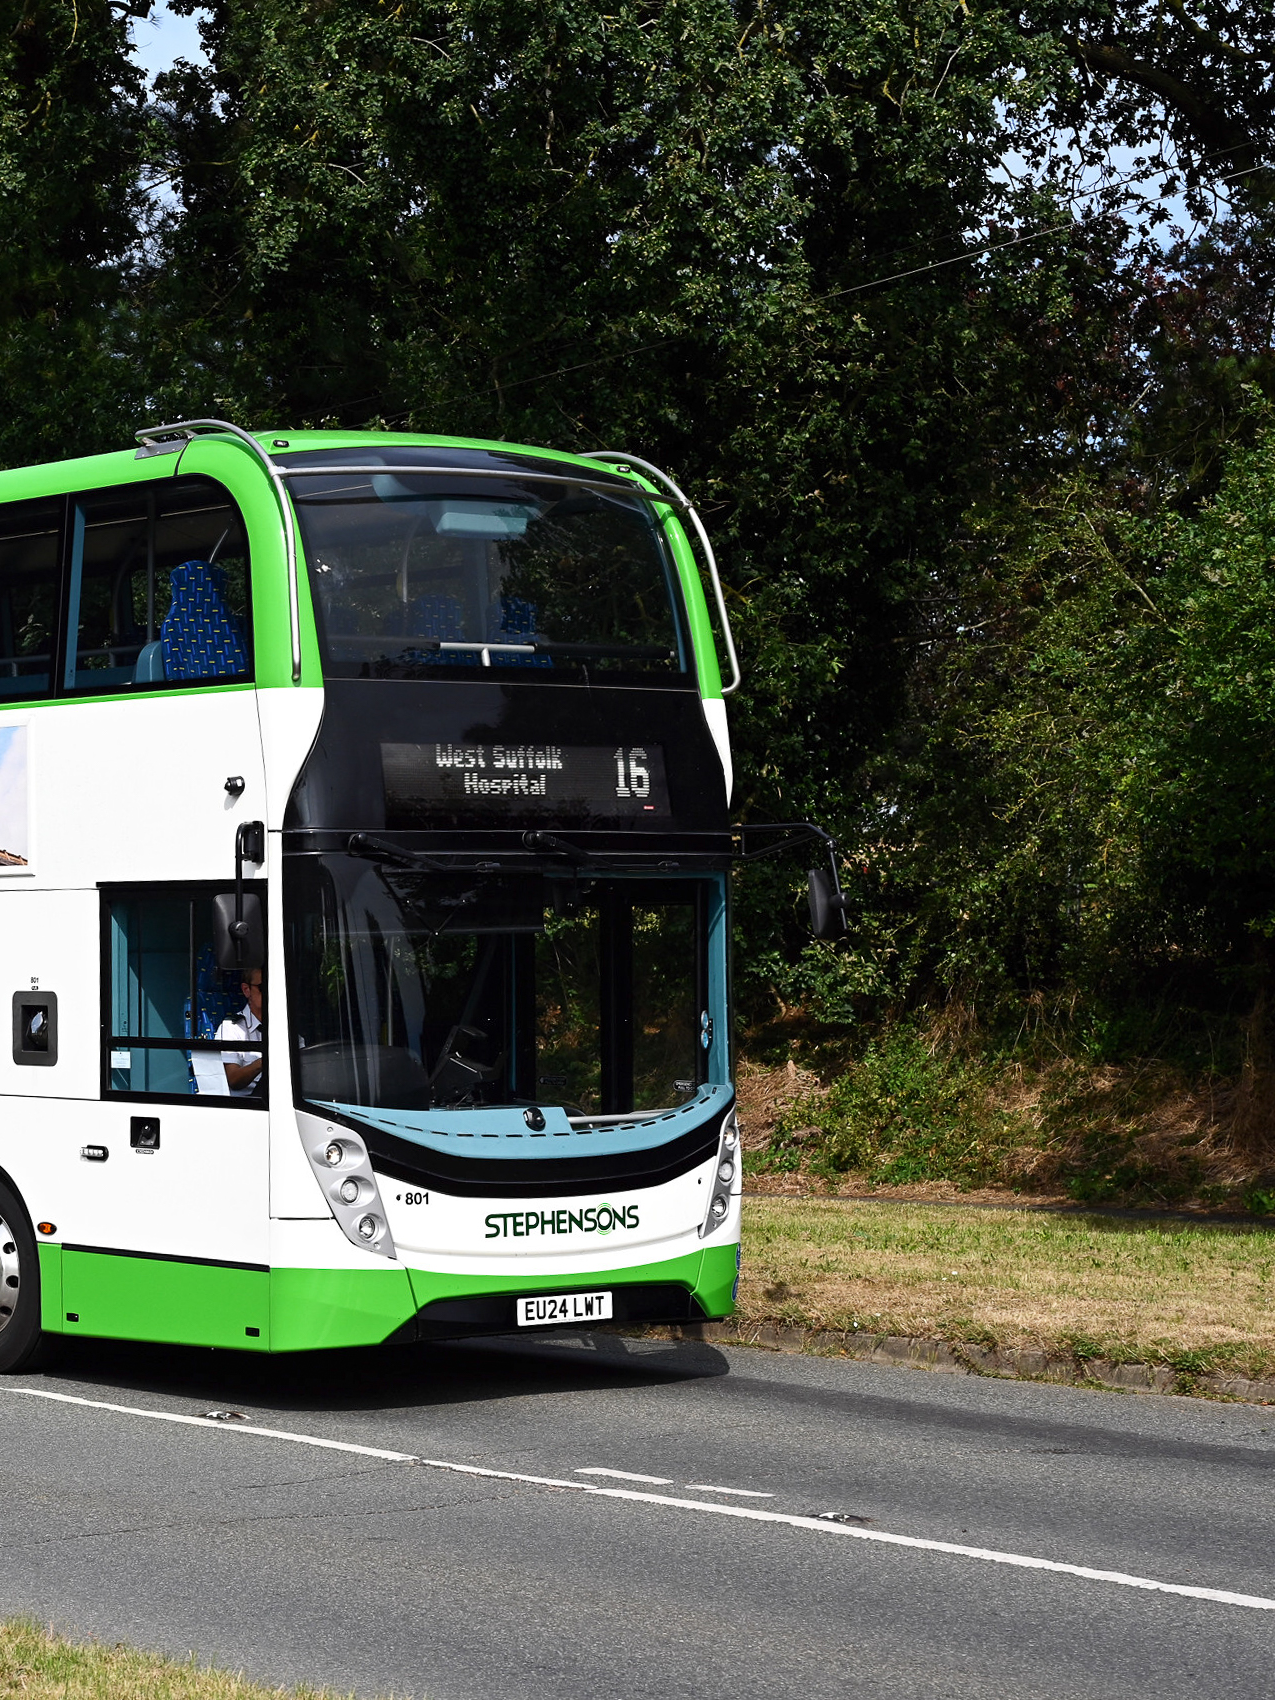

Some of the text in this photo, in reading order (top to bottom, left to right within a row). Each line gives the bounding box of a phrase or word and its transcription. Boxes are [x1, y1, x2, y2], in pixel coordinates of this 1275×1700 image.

[436, 744, 650, 797] West Suffolk 16
[464, 773, 546, 795] Hospital
[405, 1192, 430, 1205] 801
[485, 1204, 640, 1238] STEPHENSONS
[525, 1295, 604, 1321] EU24 LWT
